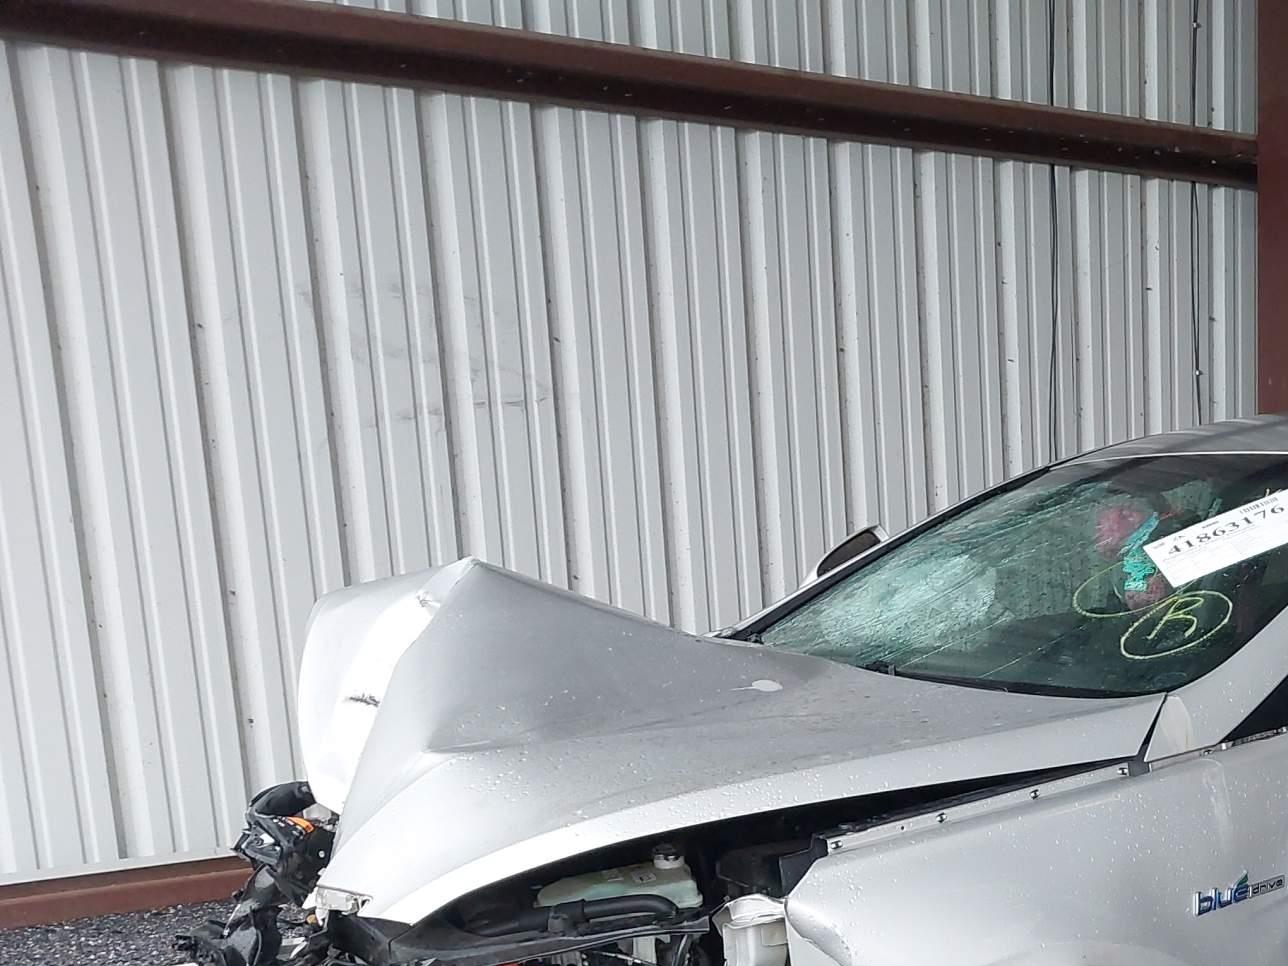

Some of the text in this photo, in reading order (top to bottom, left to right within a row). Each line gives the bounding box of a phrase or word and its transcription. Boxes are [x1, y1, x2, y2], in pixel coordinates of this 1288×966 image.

[1167, 503, 1286, 556] 41863176
[1194, 874, 1284, 917] blue drive
